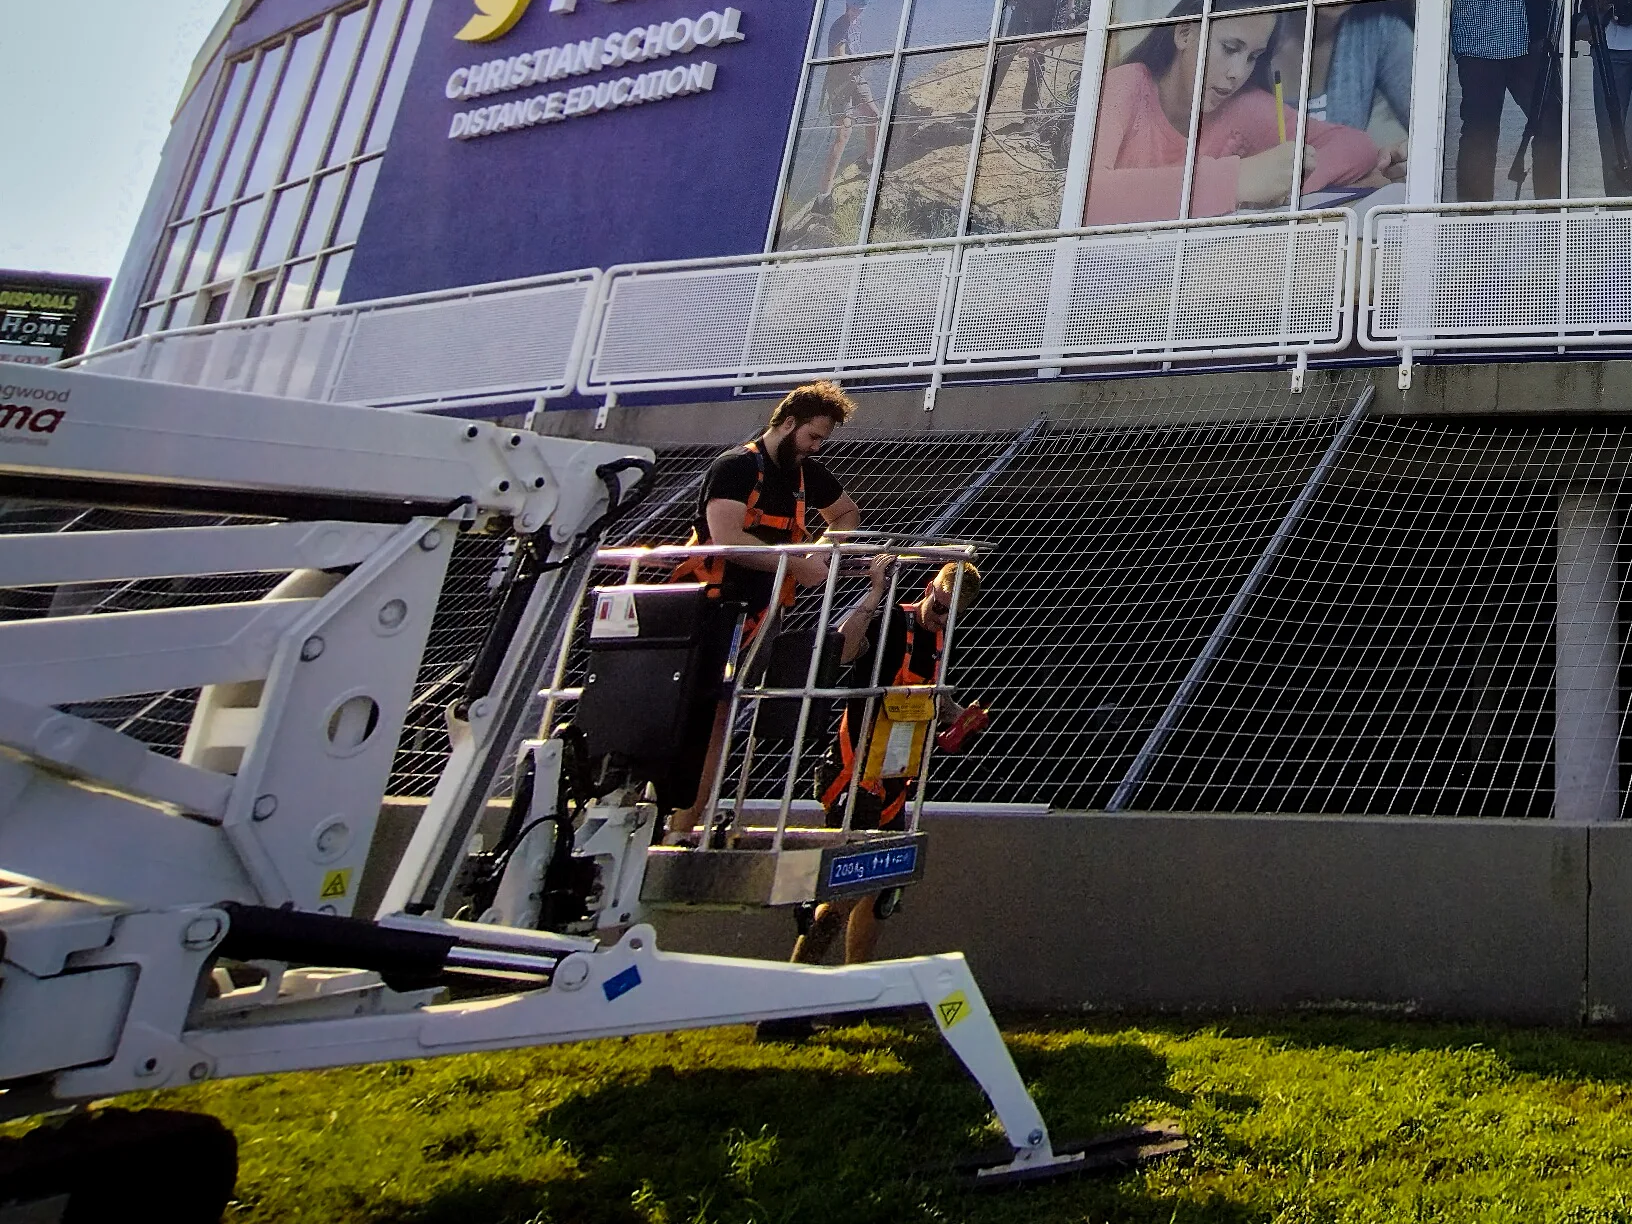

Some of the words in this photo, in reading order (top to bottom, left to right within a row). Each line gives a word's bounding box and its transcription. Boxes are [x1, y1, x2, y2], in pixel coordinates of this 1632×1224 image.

[446, 36, 601, 101] CHRISTIAN
[600, 7, 746, 66] SCHOOL
[447, 91, 566, 140] DISTANCE
[563, 61, 718, 115] EDUCATION
